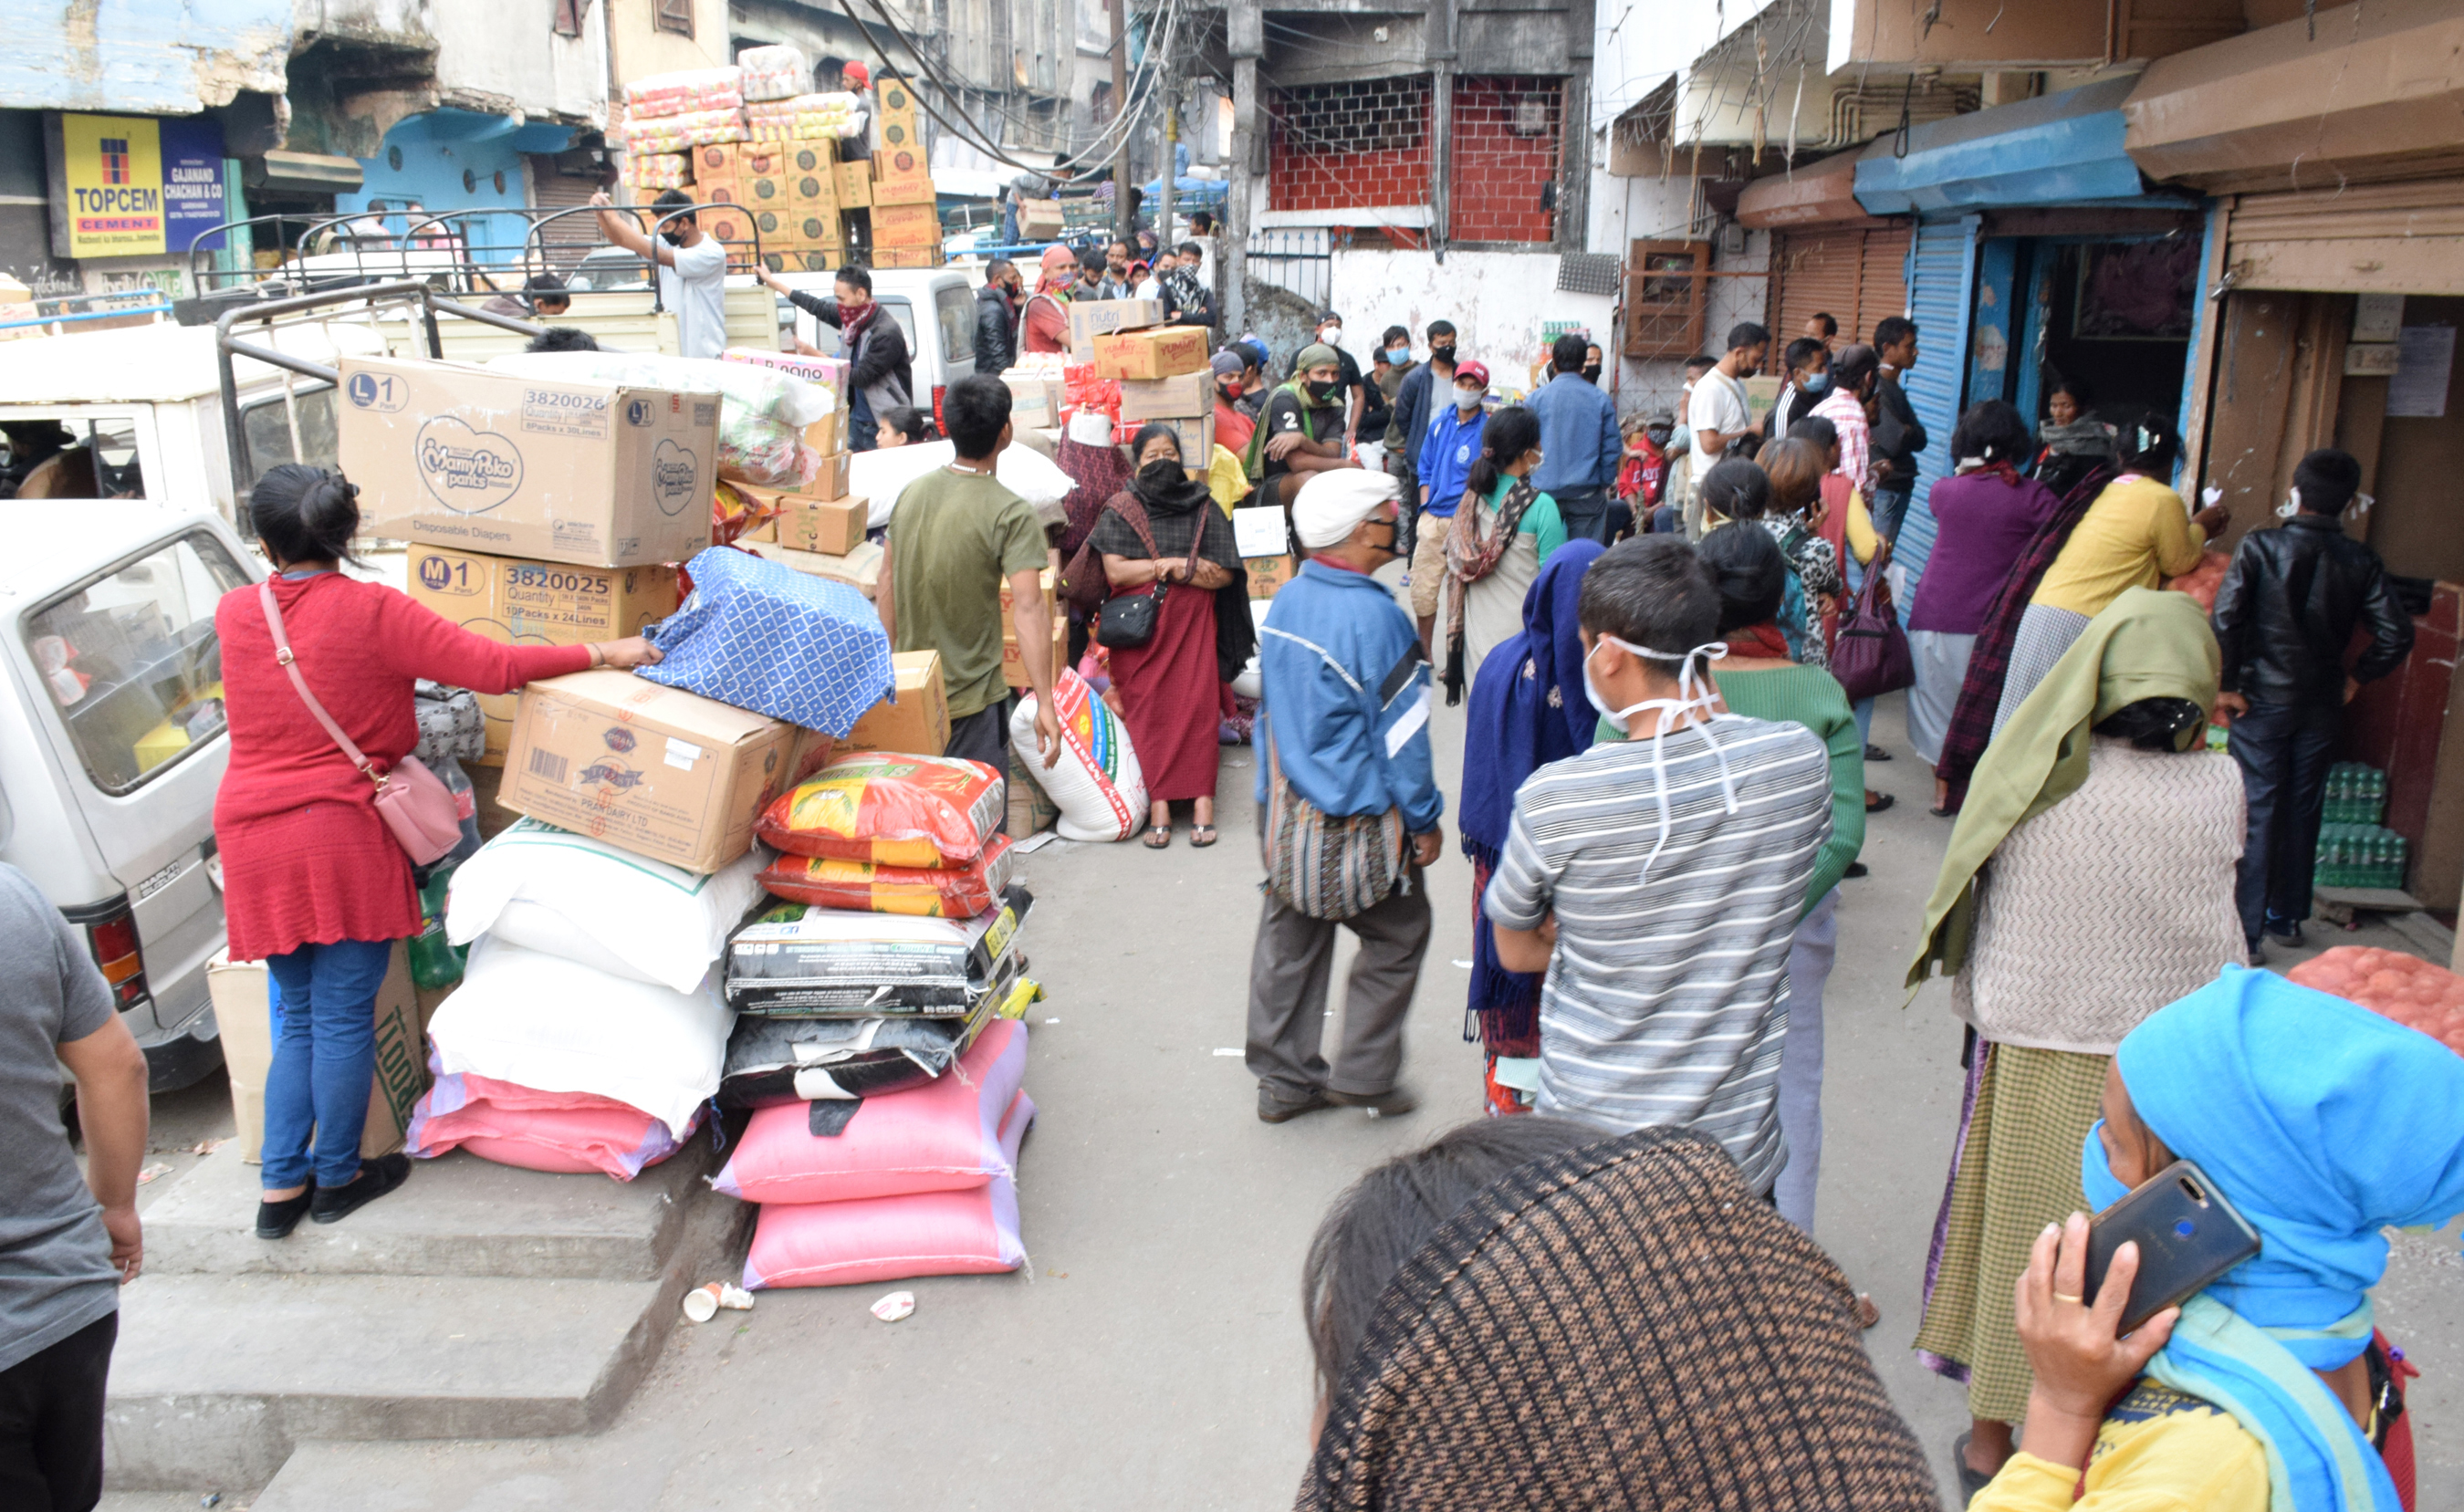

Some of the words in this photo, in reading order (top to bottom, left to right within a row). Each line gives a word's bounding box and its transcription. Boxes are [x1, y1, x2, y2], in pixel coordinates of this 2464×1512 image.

[172, 168, 214, 182] GAJANAND
[75, 188, 158, 213] TOPCEM
[164, 184, 203, 199] CHACHAN
[204, 184, 211, 197] &
[211, 184, 222, 198] CO
[81, 219, 153, 229] CEMENT
[1091, 311, 1120, 322] nutri
[1103, 344, 1135, 354] YUMMY
[1161, 339, 1196, 355] YUMMY
[779, 366, 823, 380] nano
[355, 376, 369, 398] L
[381, 377, 392, 401] 1
[527, 391, 605, 411] 3820026
[526, 406, 562, 422] Quantity
[1282, 412, 1298, 429] 2
[526, 422, 556, 433] 8Packs
[567, 426, 601, 436] 30Lines
[423, 438, 514, 478] MamyPoko
[448, 471, 487, 489] pants
[413, 520, 469, 537] Disposable
[472, 527, 511, 542] Diapers
[425, 559, 444, 580] M
[454, 561, 467, 587] 1
[506, 568, 609, 594] 3820025
[507, 587, 555, 607] Quantity
[506, 606, 548, 620] 10Packs
[553, 611, 559, 620] x
[562, 611, 606, 625] 24Lines
[580, 798, 605, 815] PRAN
[606, 804, 632, 821] DAIRY
[632, 813, 649, 828] LTD
[140, 861, 179, 891] MARUTI
[141, 869, 181, 898] SUZUKI
